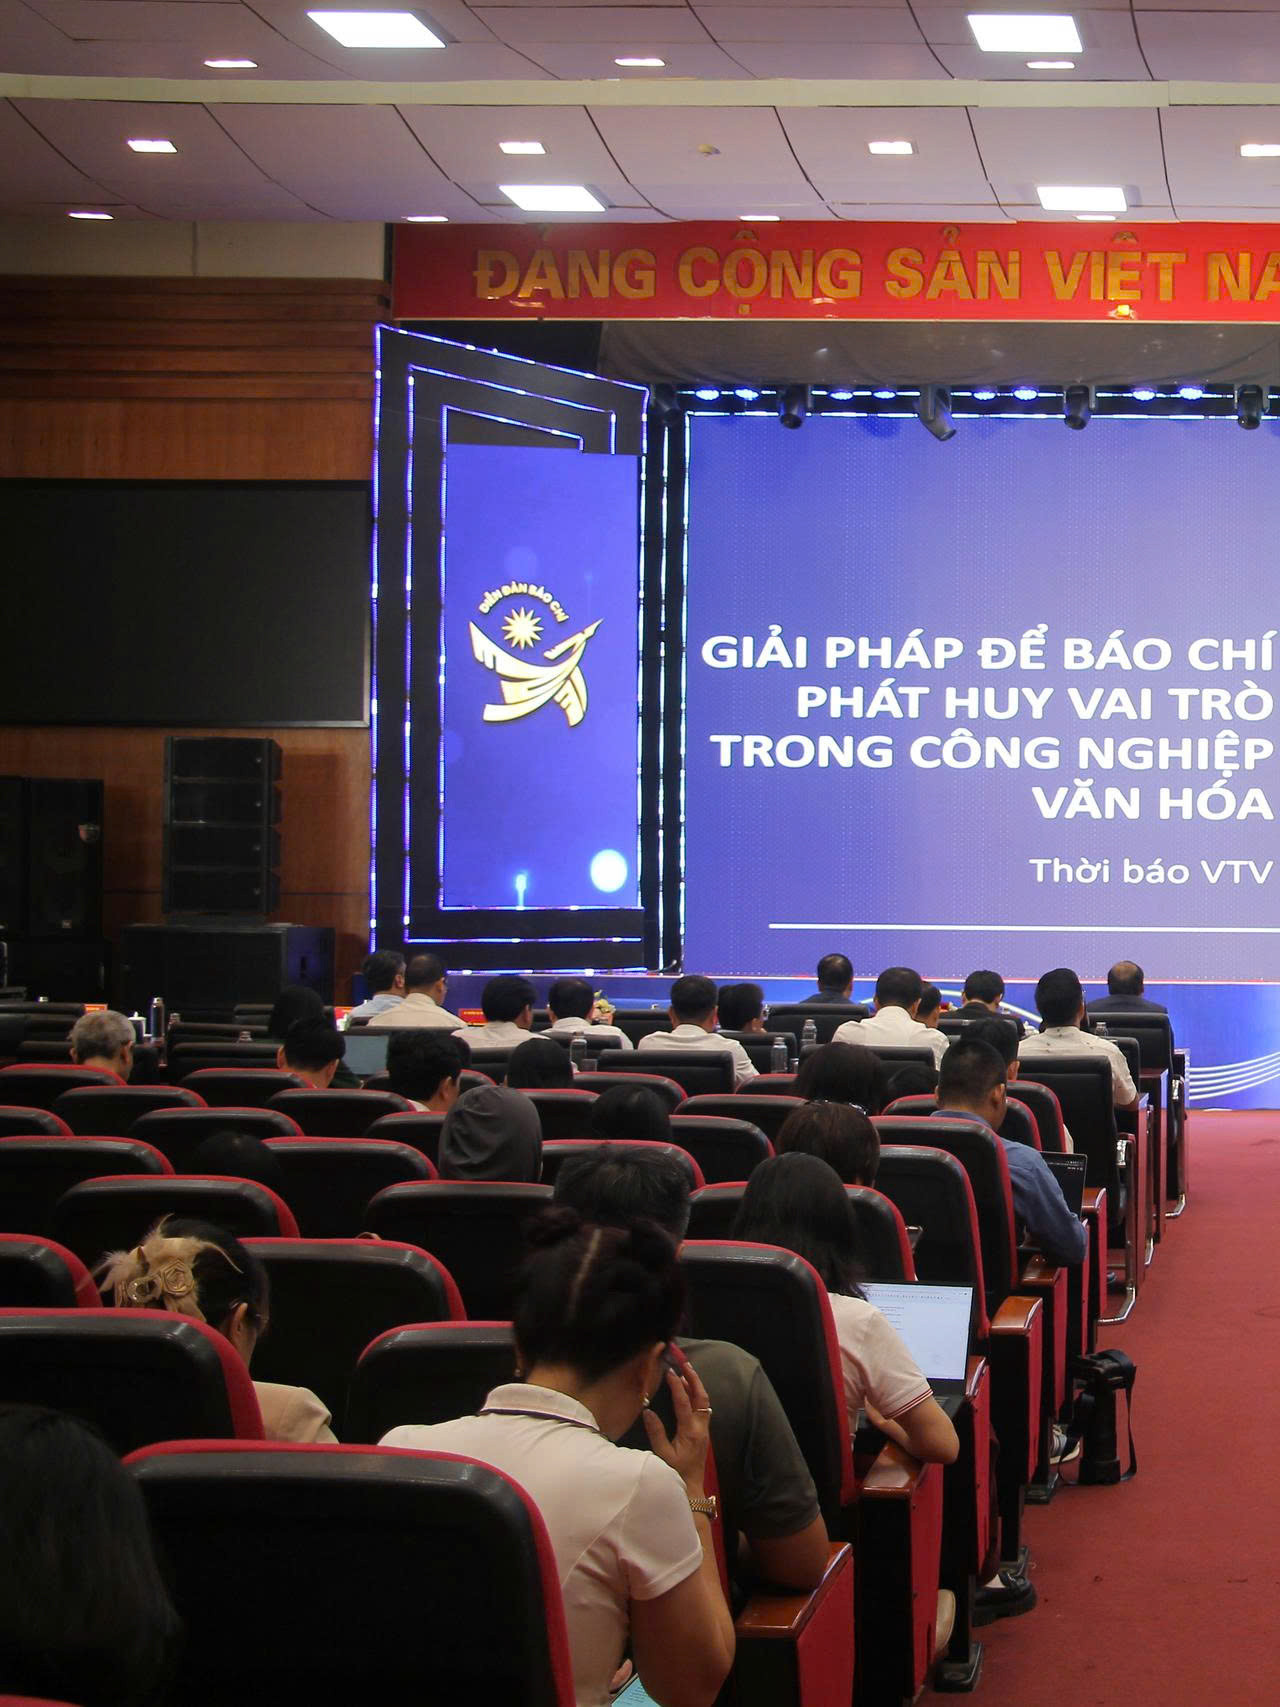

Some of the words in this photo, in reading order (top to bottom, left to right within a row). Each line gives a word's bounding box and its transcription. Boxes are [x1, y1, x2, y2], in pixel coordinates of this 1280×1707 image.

[678, 230, 862, 314] CỘNG
[885, 225, 1020, 300] SẢN
[1045, 231, 1186, 315] VIỆT
[701, 624, 807, 669] GIẢI
[826, 628, 964, 669] PHÁP
[977, 623, 1049, 670] ĐỂ
[1063, 629, 1172, 671] BÁO
[1188, 630, 1278, 671] CHÍ
[797, 677, 931, 719] PHÁT
[945, 687, 1054, 720] HUY
[1067, 687, 1152, 720] VAI
[1167, 679, 1274, 721] TRÒ
[709, 734, 893, 768] TRONG
[910, 727, 1060, 770] CÔNG
[1078, 729, 1274, 778] NGHIỆP
[1031, 778, 1140, 820] VĂN
[1159, 779, 1275, 821] HÓA
[1029, 857, 1110, 884] Thời
[1123, 857, 1190, 884] báo
[1200, 860, 1274, 884] VTV
